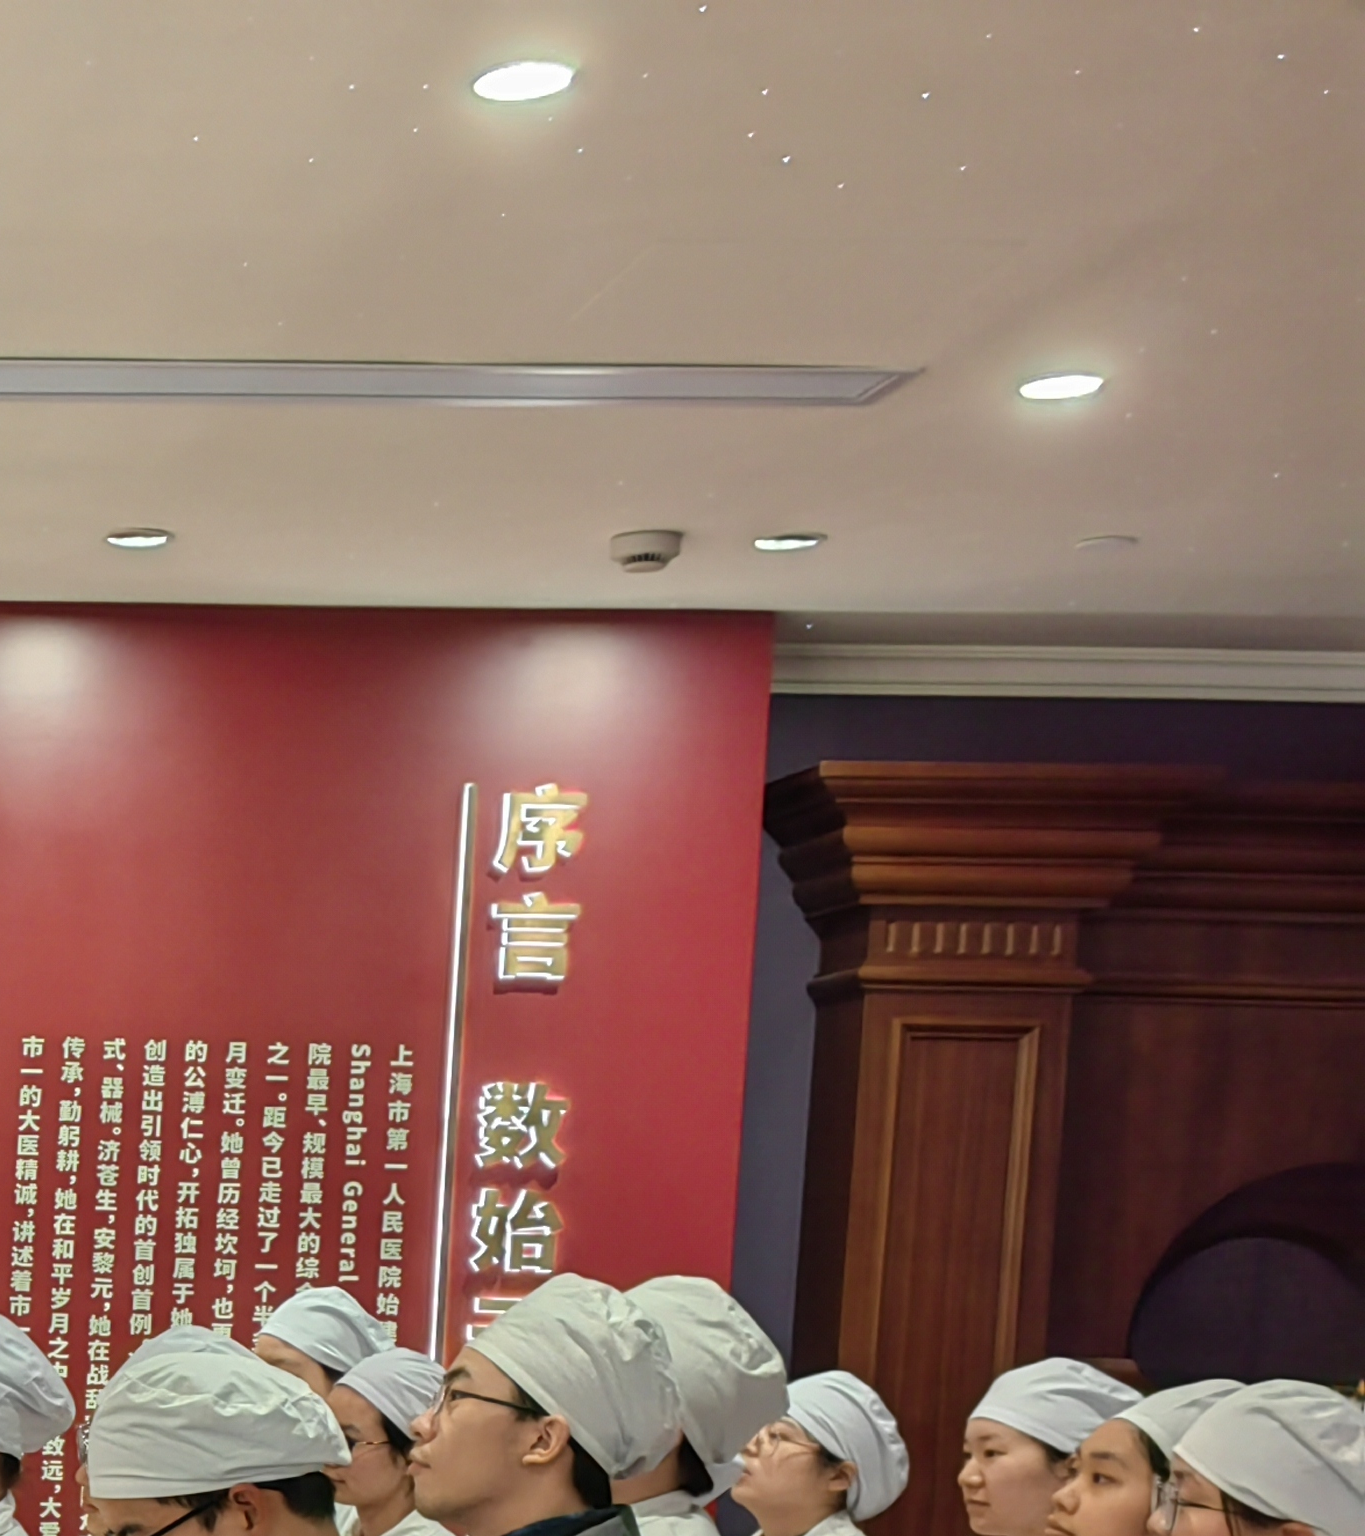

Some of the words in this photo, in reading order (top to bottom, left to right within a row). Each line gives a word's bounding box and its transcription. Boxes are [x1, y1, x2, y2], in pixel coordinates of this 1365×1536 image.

[490, 782, 590, 981] 序言
[342, 1043, 371, 1167] Shanghai
[251, 1042, 290, 1354] 之一。距今已走过了一个半
[337, 1180, 364, 1283] General
